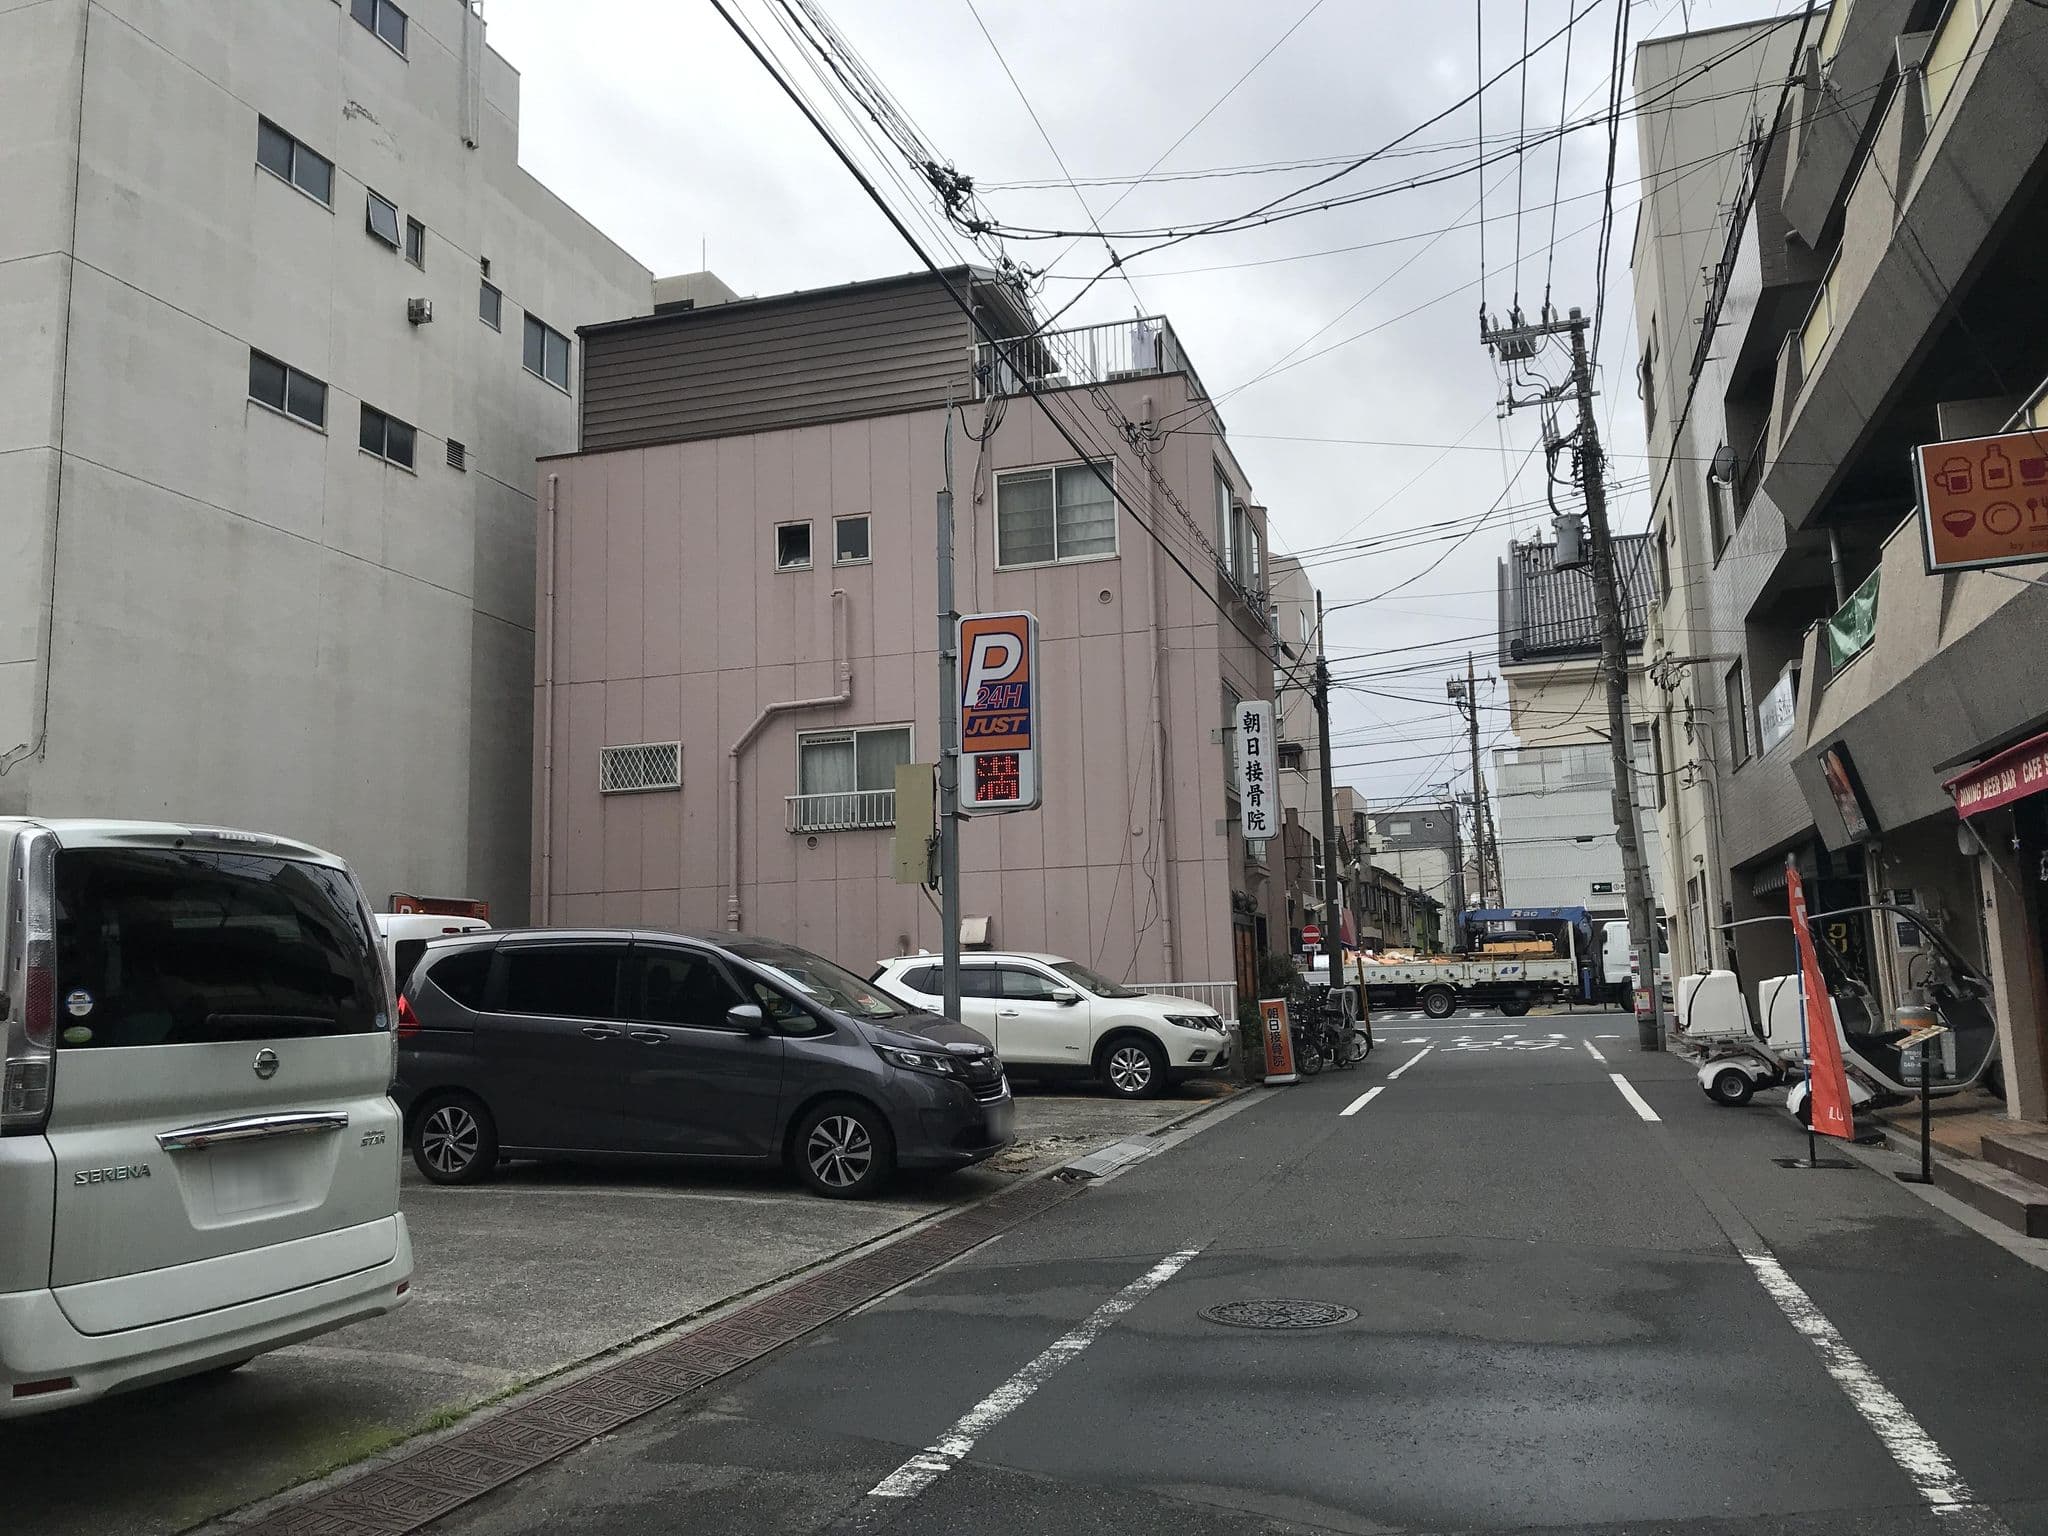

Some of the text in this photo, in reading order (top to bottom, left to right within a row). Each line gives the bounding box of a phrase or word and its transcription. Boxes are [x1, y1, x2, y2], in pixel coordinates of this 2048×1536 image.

[963, 632, 1023, 707] P
[975, 684, 1023, 710] 24H
[966, 715, 1028, 736] JUST
[1242, 711, 1266, 831] 朝日接骨院
[1959, 782, 1982, 808] DINING
[1983, 775, 2001, 799] BEER
[2001, 768, 2017, 792] BAR
[2022, 757, 2043, 783] CAFE
[360, 1135, 386, 1148] STAR
[74, 1163, 151, 1186] SERENA
